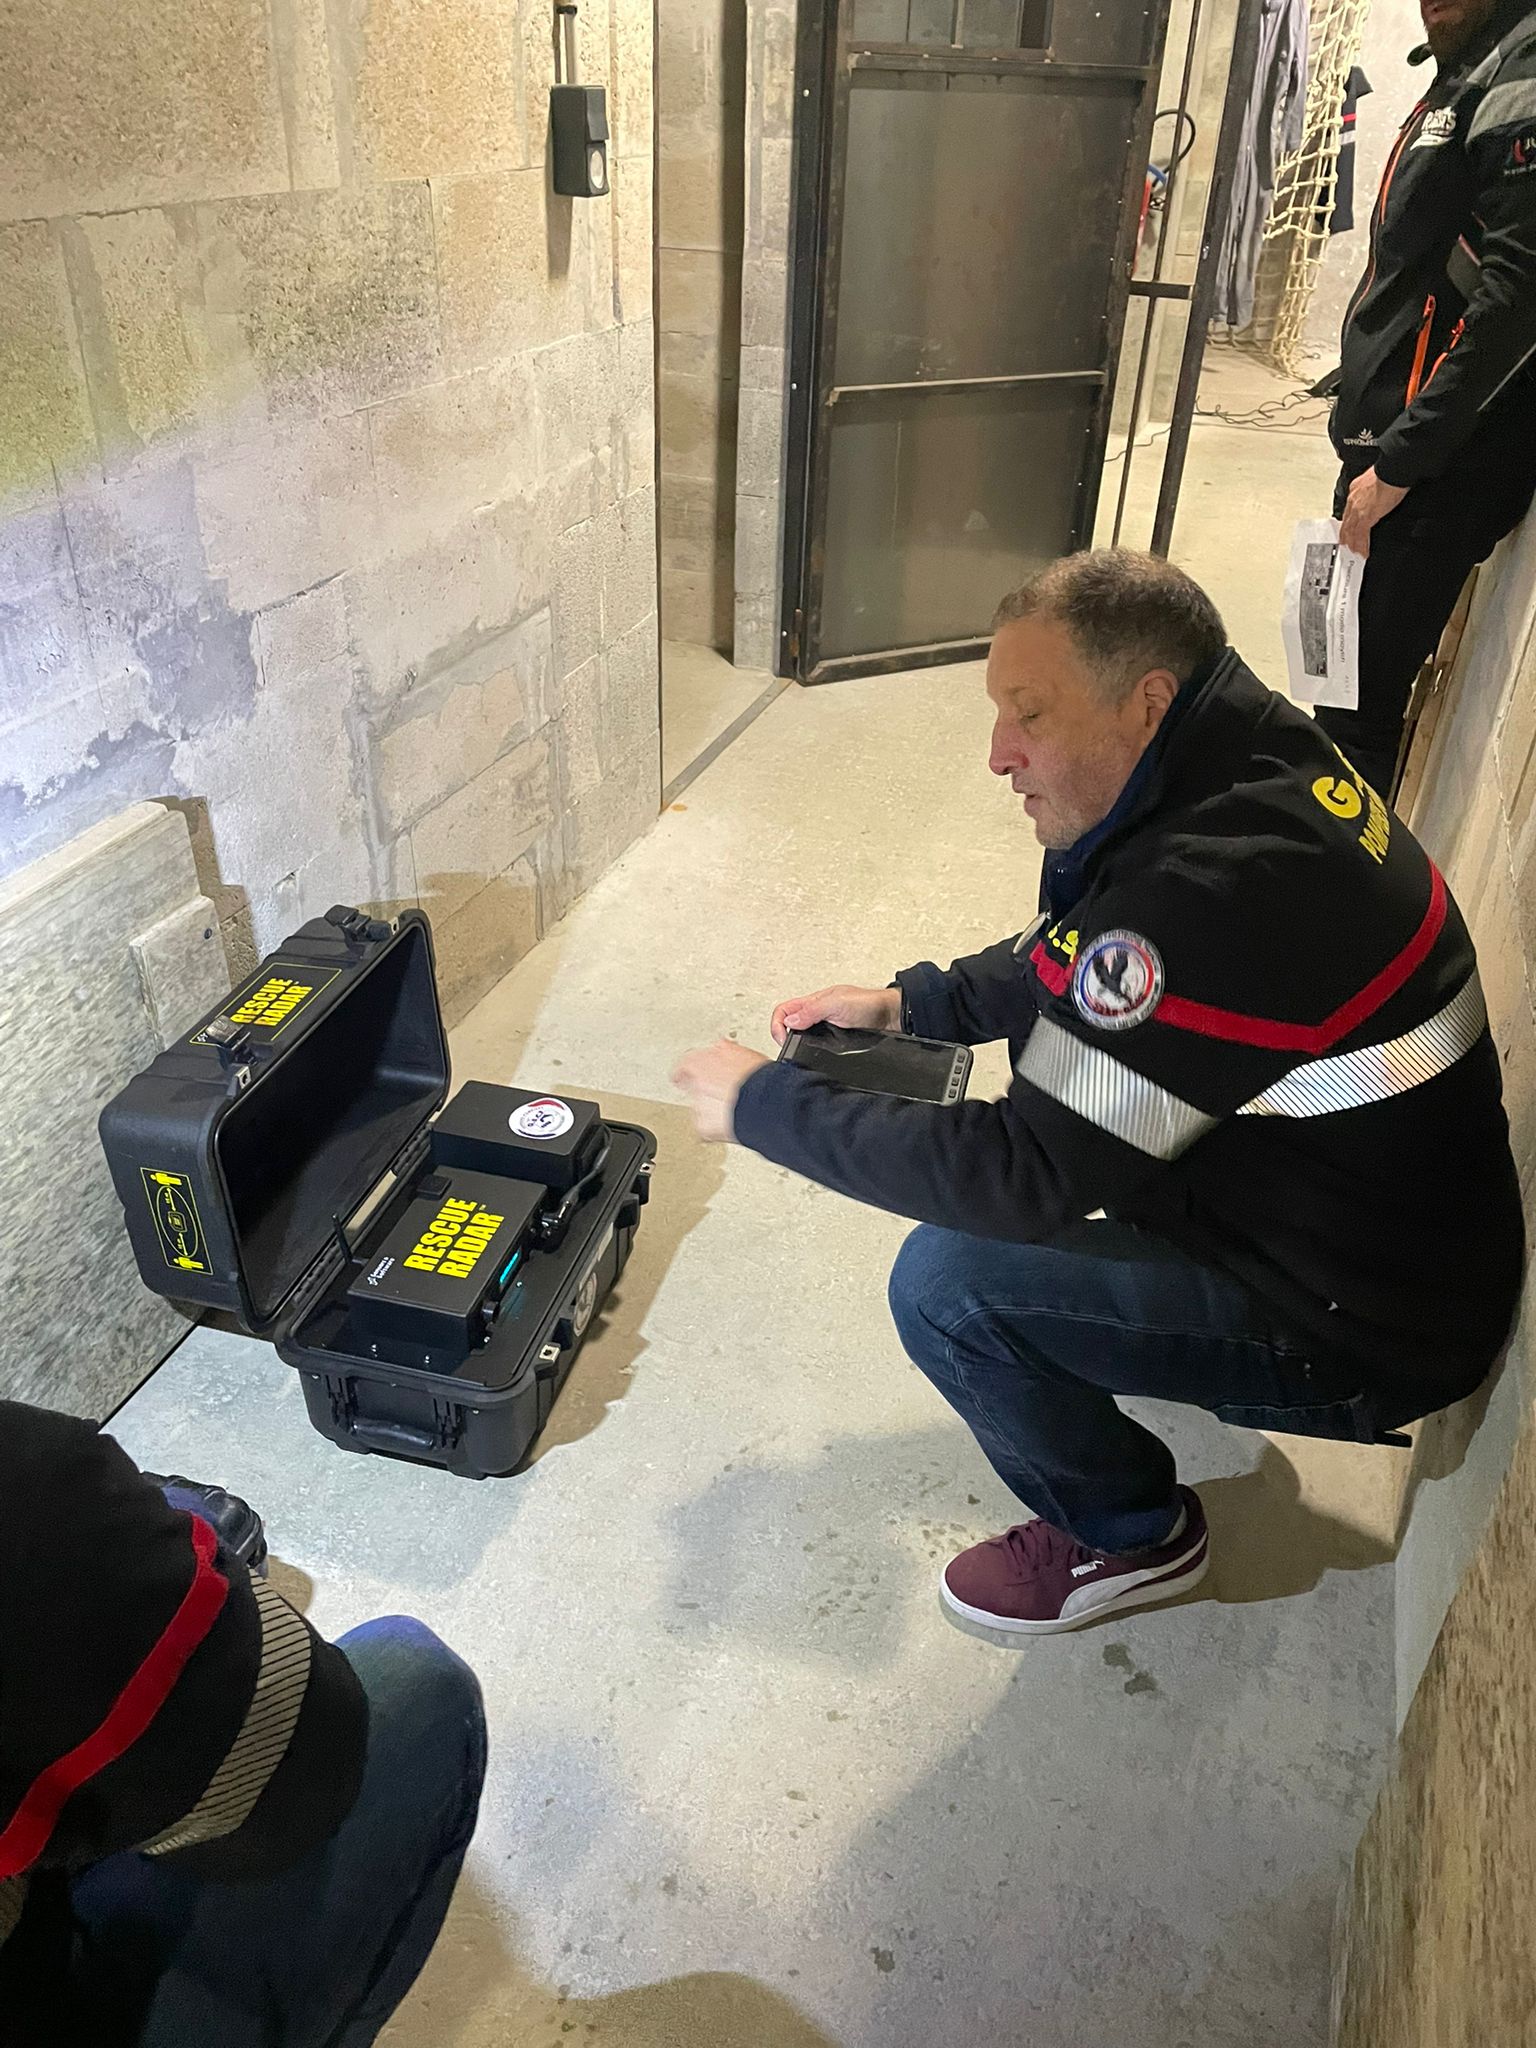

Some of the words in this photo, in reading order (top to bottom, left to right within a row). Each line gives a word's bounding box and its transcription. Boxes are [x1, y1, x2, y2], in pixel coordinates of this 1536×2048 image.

[230, 978, 293, 1024] RESCUE
[253, 985, 313, 1027] RADAR
[403, 1196, 478, 1272] RESCUE
[436, 1212, 505, 1279] RADAR
[1071, 1561, 1098, 1578] PUMA
